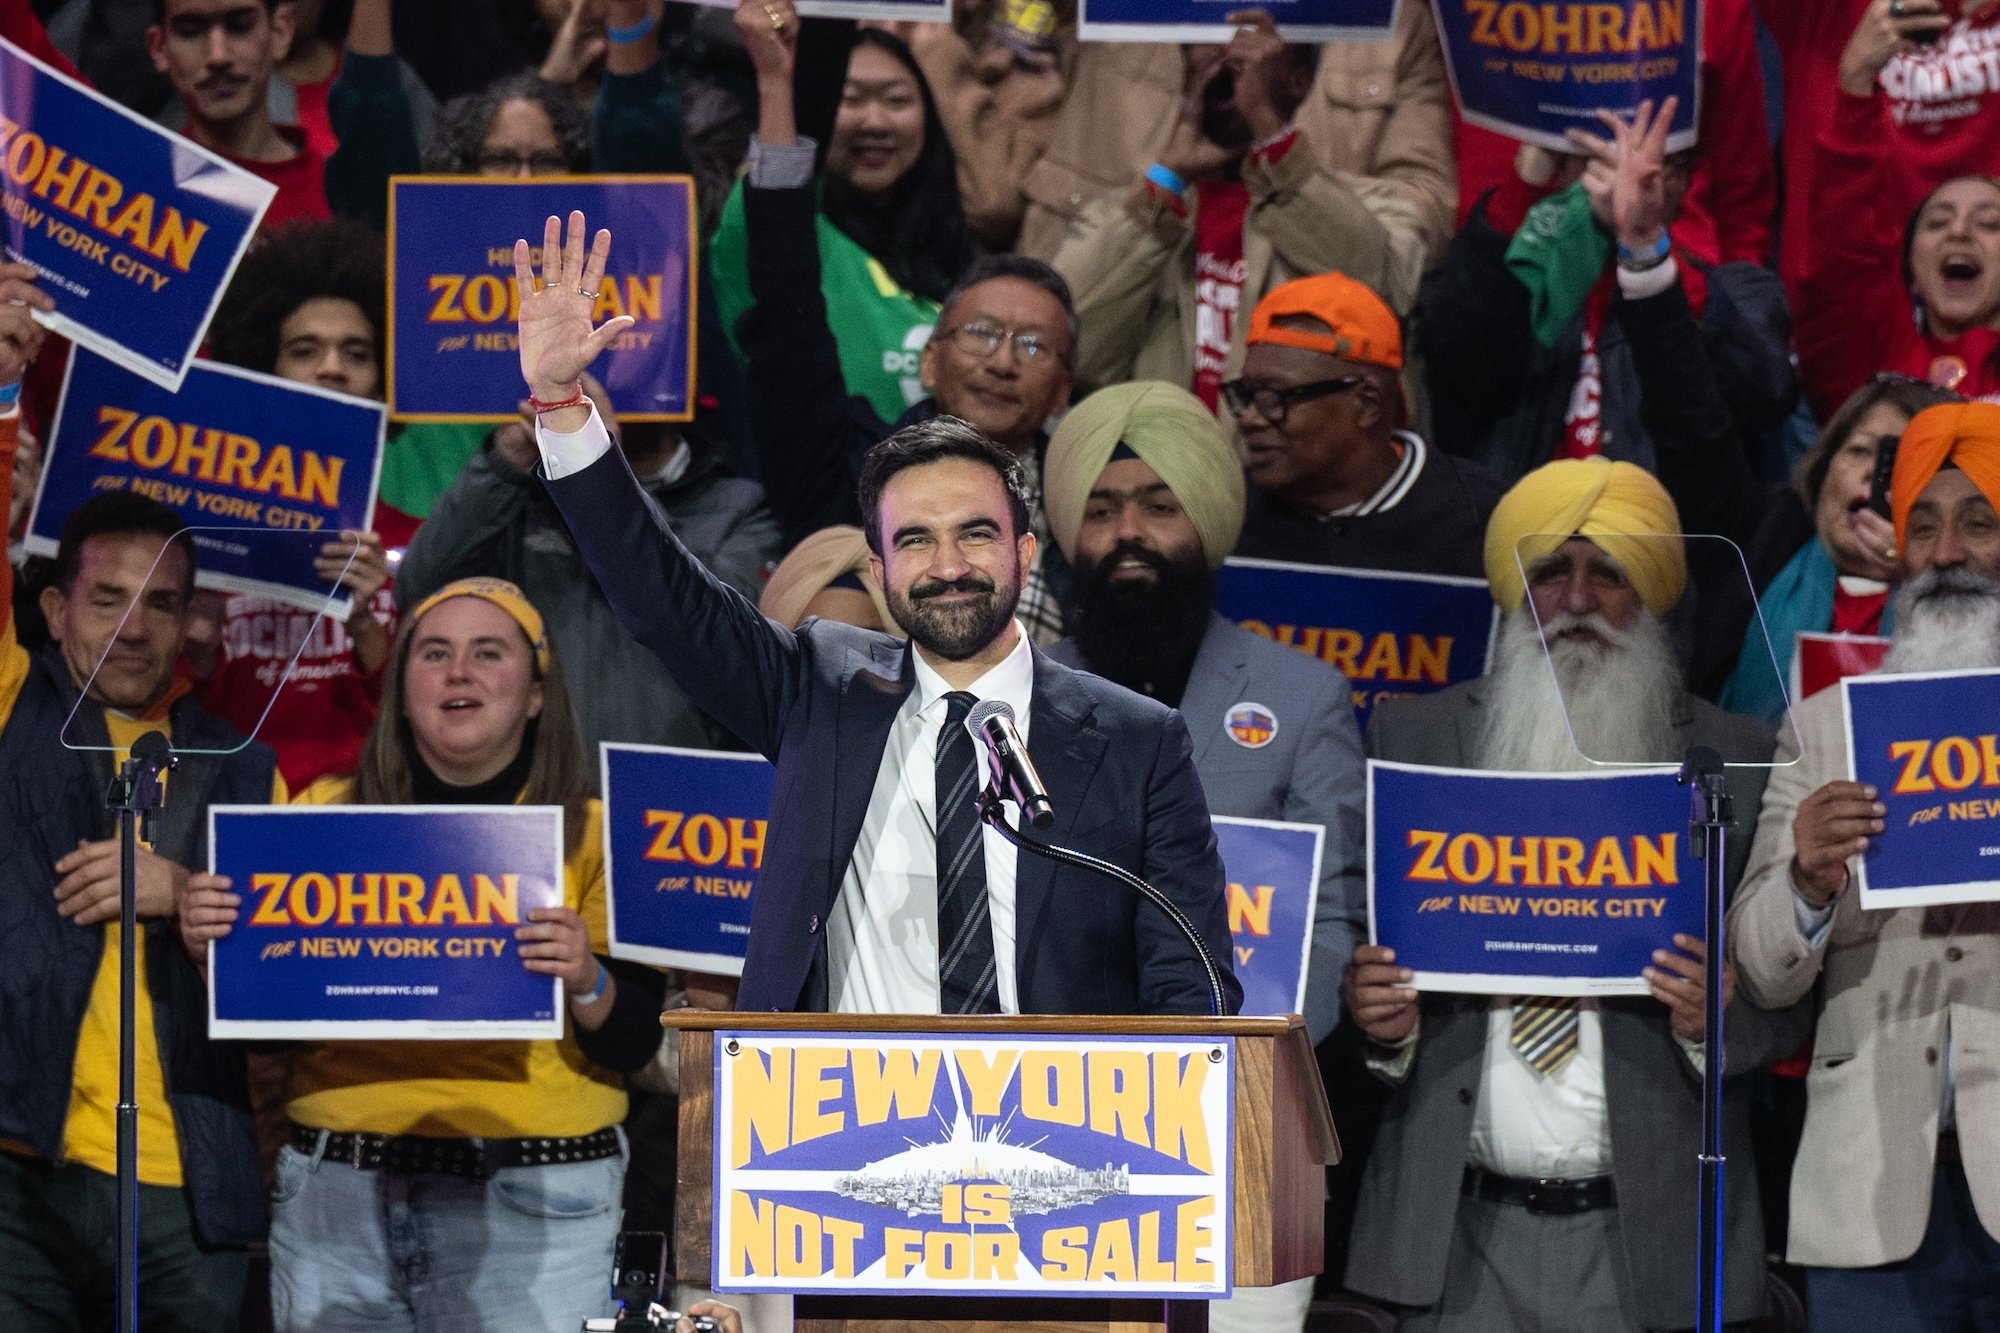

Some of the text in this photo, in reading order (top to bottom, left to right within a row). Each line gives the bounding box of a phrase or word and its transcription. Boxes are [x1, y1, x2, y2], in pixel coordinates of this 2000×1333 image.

[1463, 0, 1686, 54] ZOHRAN
[1511, 60, 1566, 83] NEW
[1570, 63, 1636, 84] YORK
[47, 216, 110, 265] YORK
[111, 252, 170, 293] CITY
[427, 274, 663, 323] ZOAN
[89, 404, 346, 509] ZOHRAN
[130, 475, 191, 507] NEW
[196, 490, 263, 523] YORK
[265, 506, 325, 534] CITY
[1889, 733, 2000, 796] ZOH
[642, 808, 768, 872] ZOH
[1908, 805, 1944, 828] FOR
[655, 875, 752, 900] FOR NEW
[1405, 829, 1680, 889] ZOHRAN
[248, 871, 520, 929] ZOHRAN
[1417, 894, 1667, 918] FOR NEW YORK CITY
[260, 937, 507, 961] FOR NEW YORK CITY
[731, 1047, 1216, 1176] NEW YORK
[942, 1184, 1010, 1225] IS
[729, 1189, 1216, 1283] NOT FOR SALE
